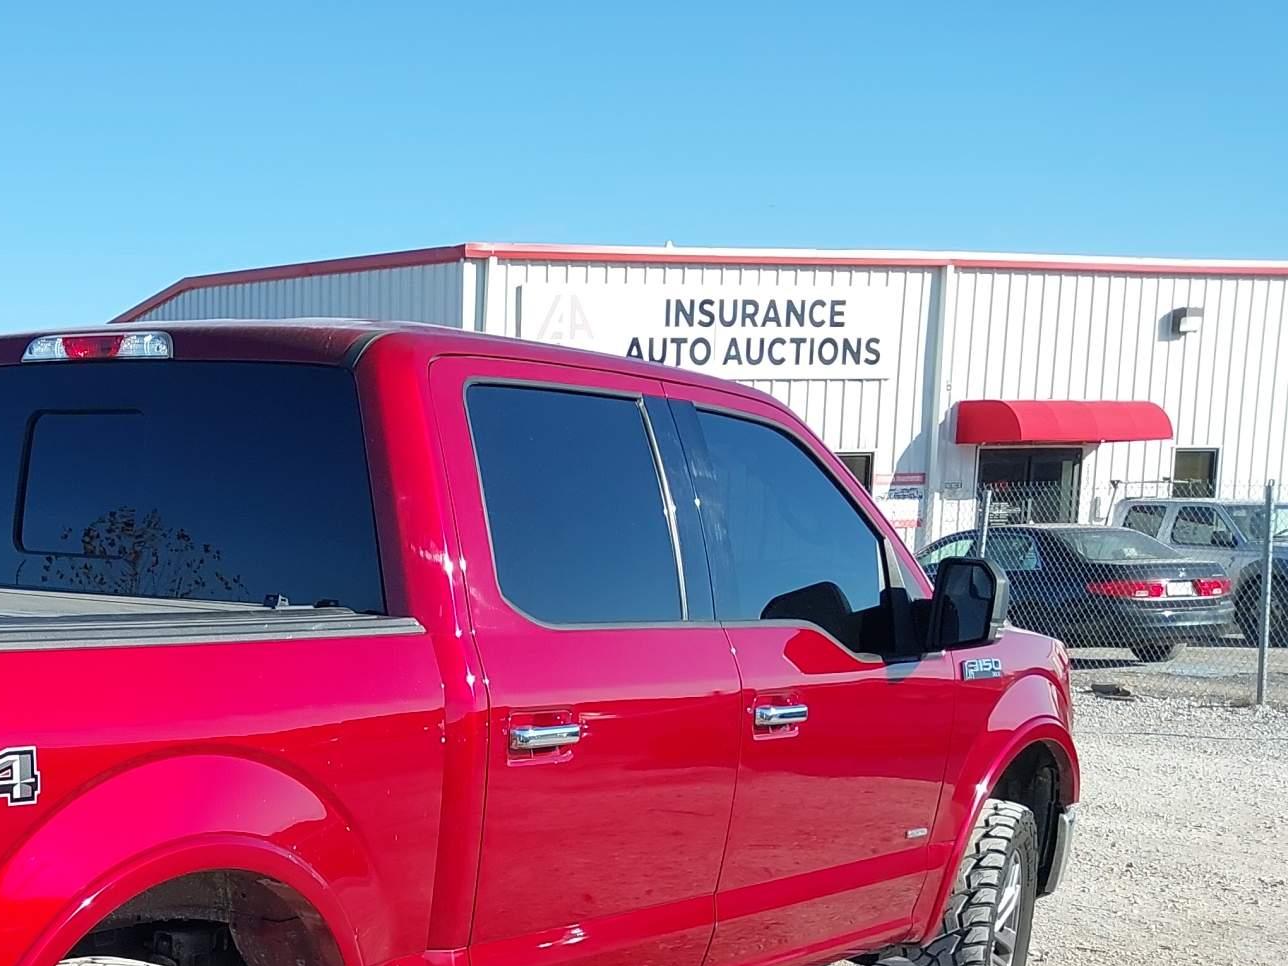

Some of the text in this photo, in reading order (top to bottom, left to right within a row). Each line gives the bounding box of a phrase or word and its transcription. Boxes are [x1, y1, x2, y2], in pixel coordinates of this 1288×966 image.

[664, 299, 847, 328] INSURANCE
[626, 337, 881, 368] AUTO AUCTIONS
